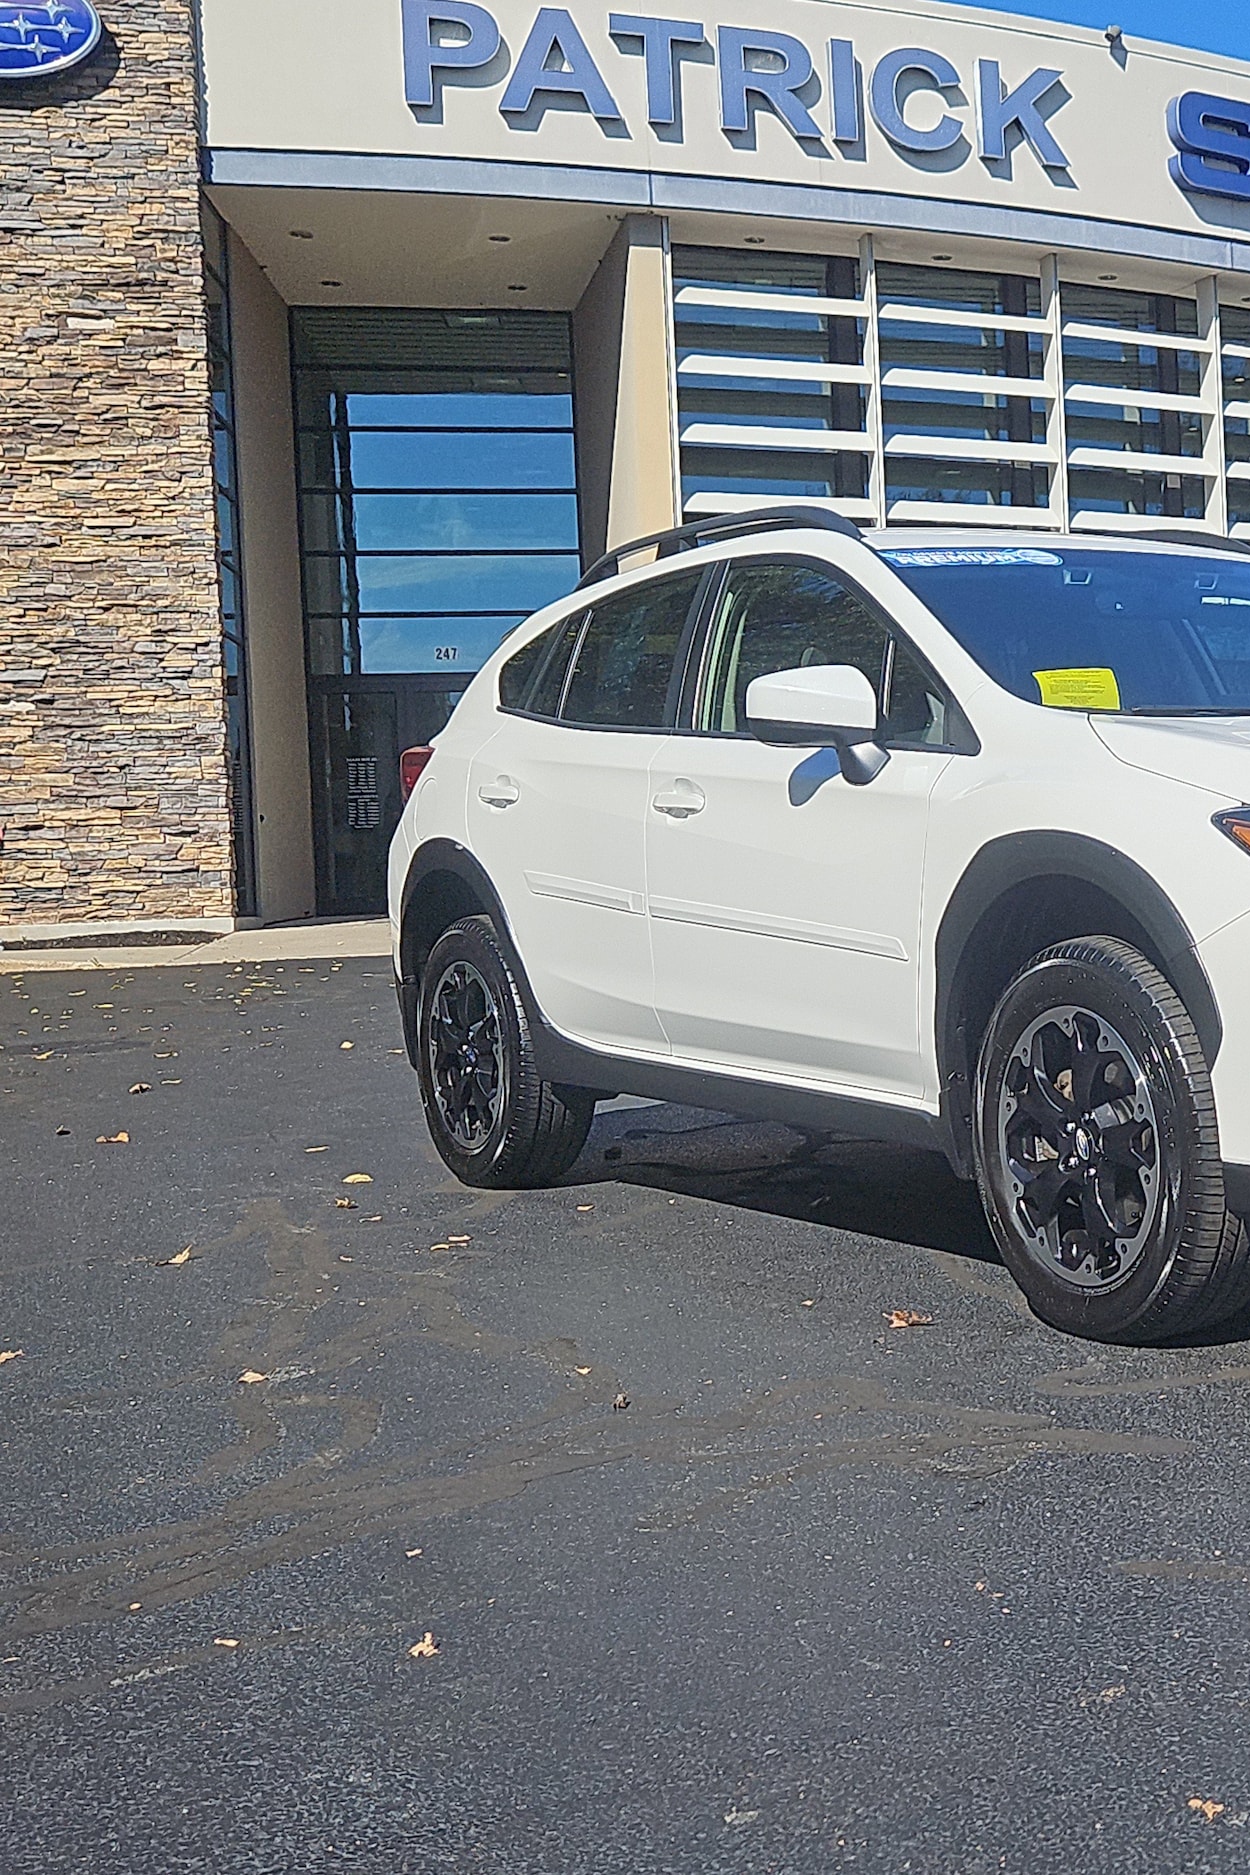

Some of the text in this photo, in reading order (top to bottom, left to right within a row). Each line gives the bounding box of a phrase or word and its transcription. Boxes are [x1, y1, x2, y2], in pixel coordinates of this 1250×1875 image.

[402, 0, 1073, 170] PATRICK
[896, 551, 1018, 566] PREMIUM
[435, 647, 458, 660] 247
